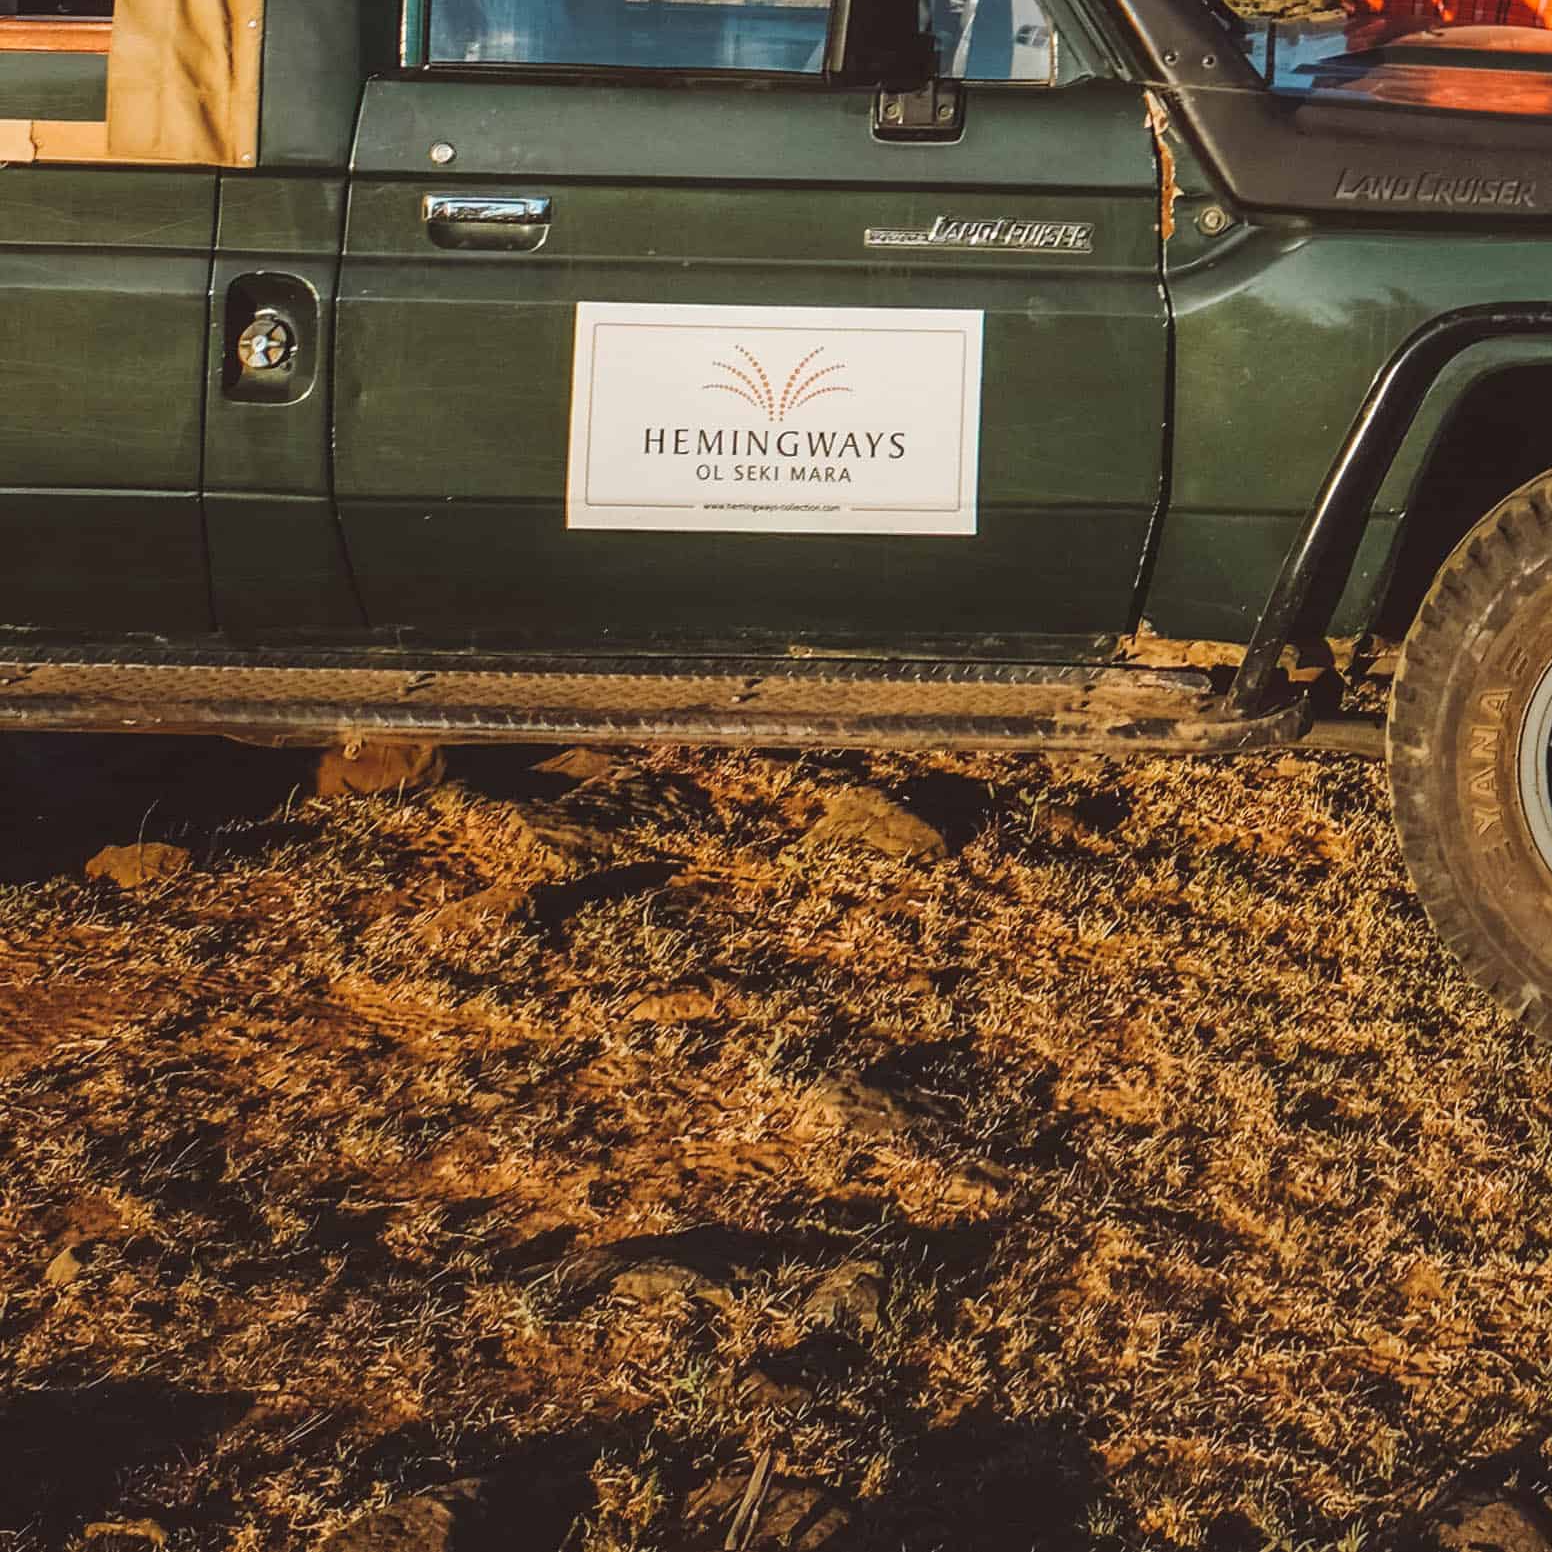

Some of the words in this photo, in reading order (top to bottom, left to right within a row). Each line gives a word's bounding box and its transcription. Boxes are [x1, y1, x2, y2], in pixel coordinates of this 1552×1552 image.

[644, 428, 906, 459] HEMINGWAYS
[696, 464, 724, 481] OL
[734, 465, 779, 482] SEKI
[790, 466, 851, 483] MARA
[1471, 687, 1513, 836] YANA
